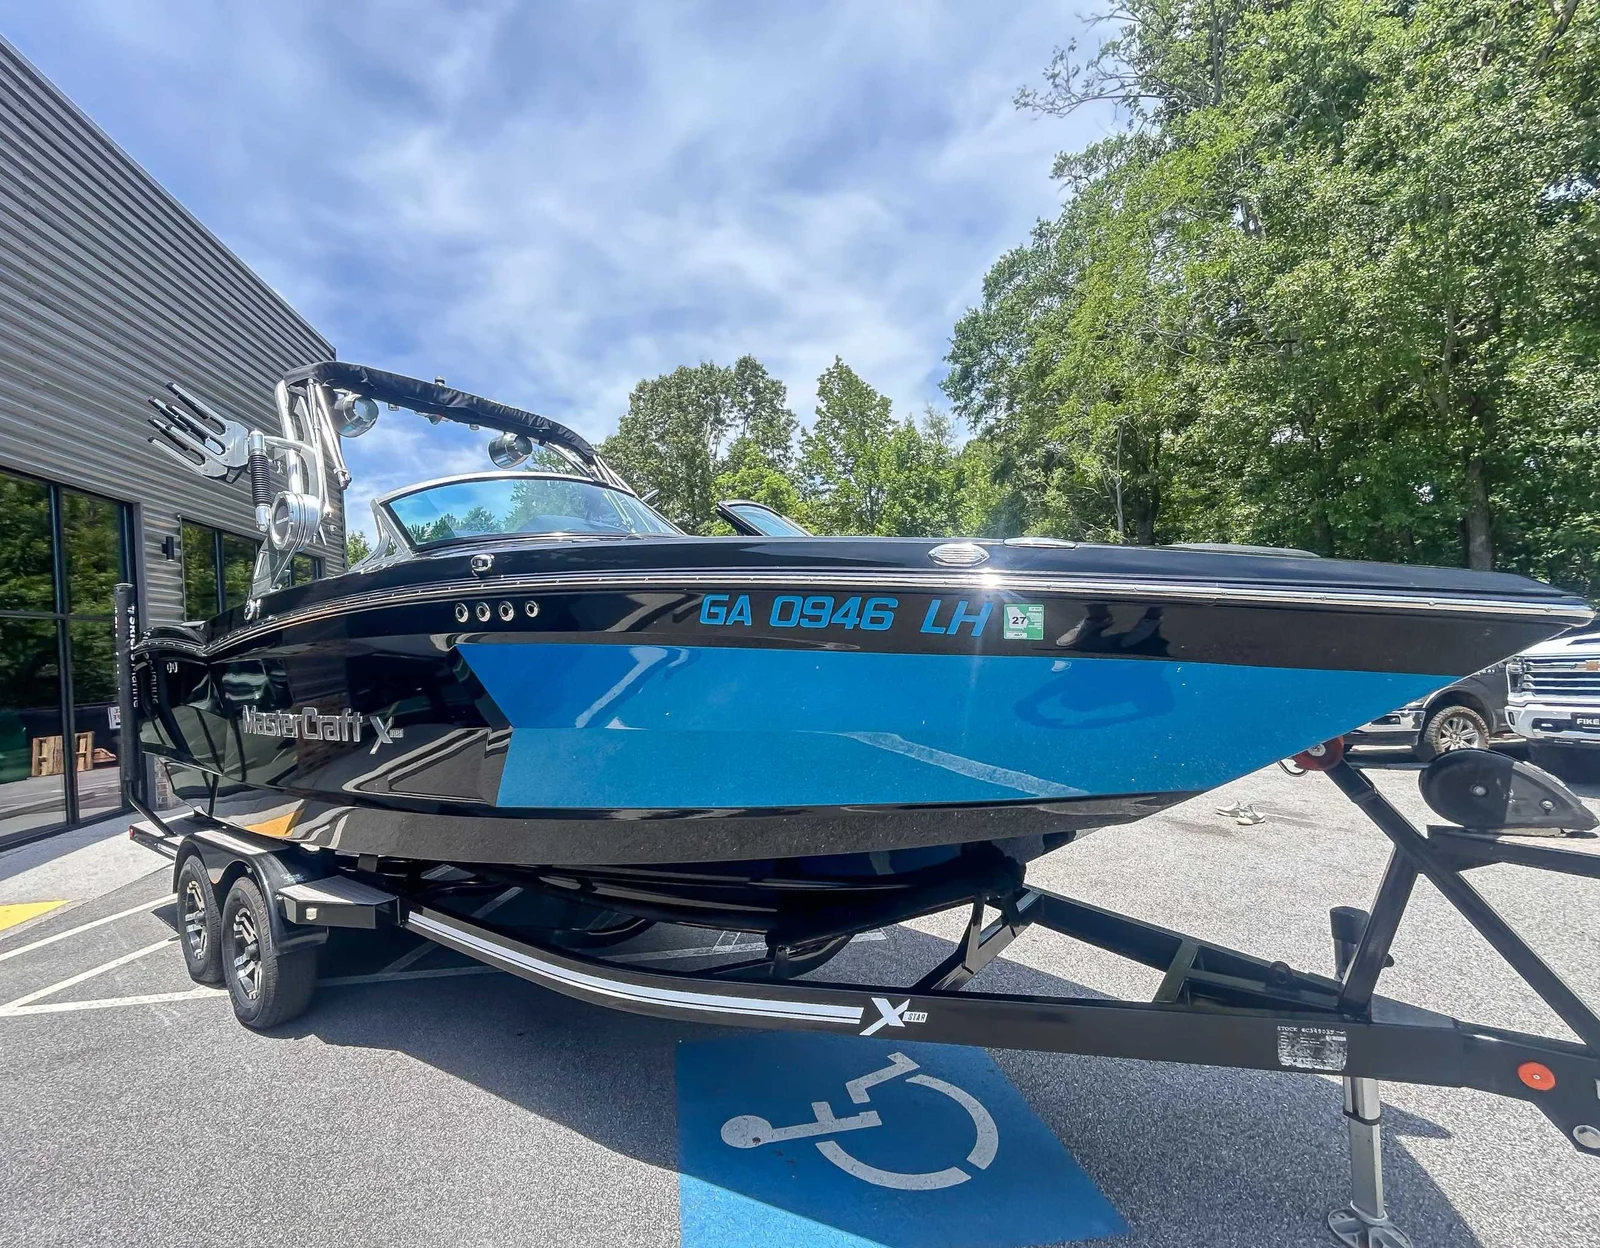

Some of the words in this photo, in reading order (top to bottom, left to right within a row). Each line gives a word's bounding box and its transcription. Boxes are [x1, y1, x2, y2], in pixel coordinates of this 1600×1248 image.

[700, 594, 751, 626] GA
[769, 596, 898, 631] 0946
[920, 600, 993, 637] LH
[1012, 616, 1026, 625] 27
[242, 704, 363, 742] MasterCraft
[859, 997, 911, 1036] X
[907, 1013, 926, 1022] STAR
